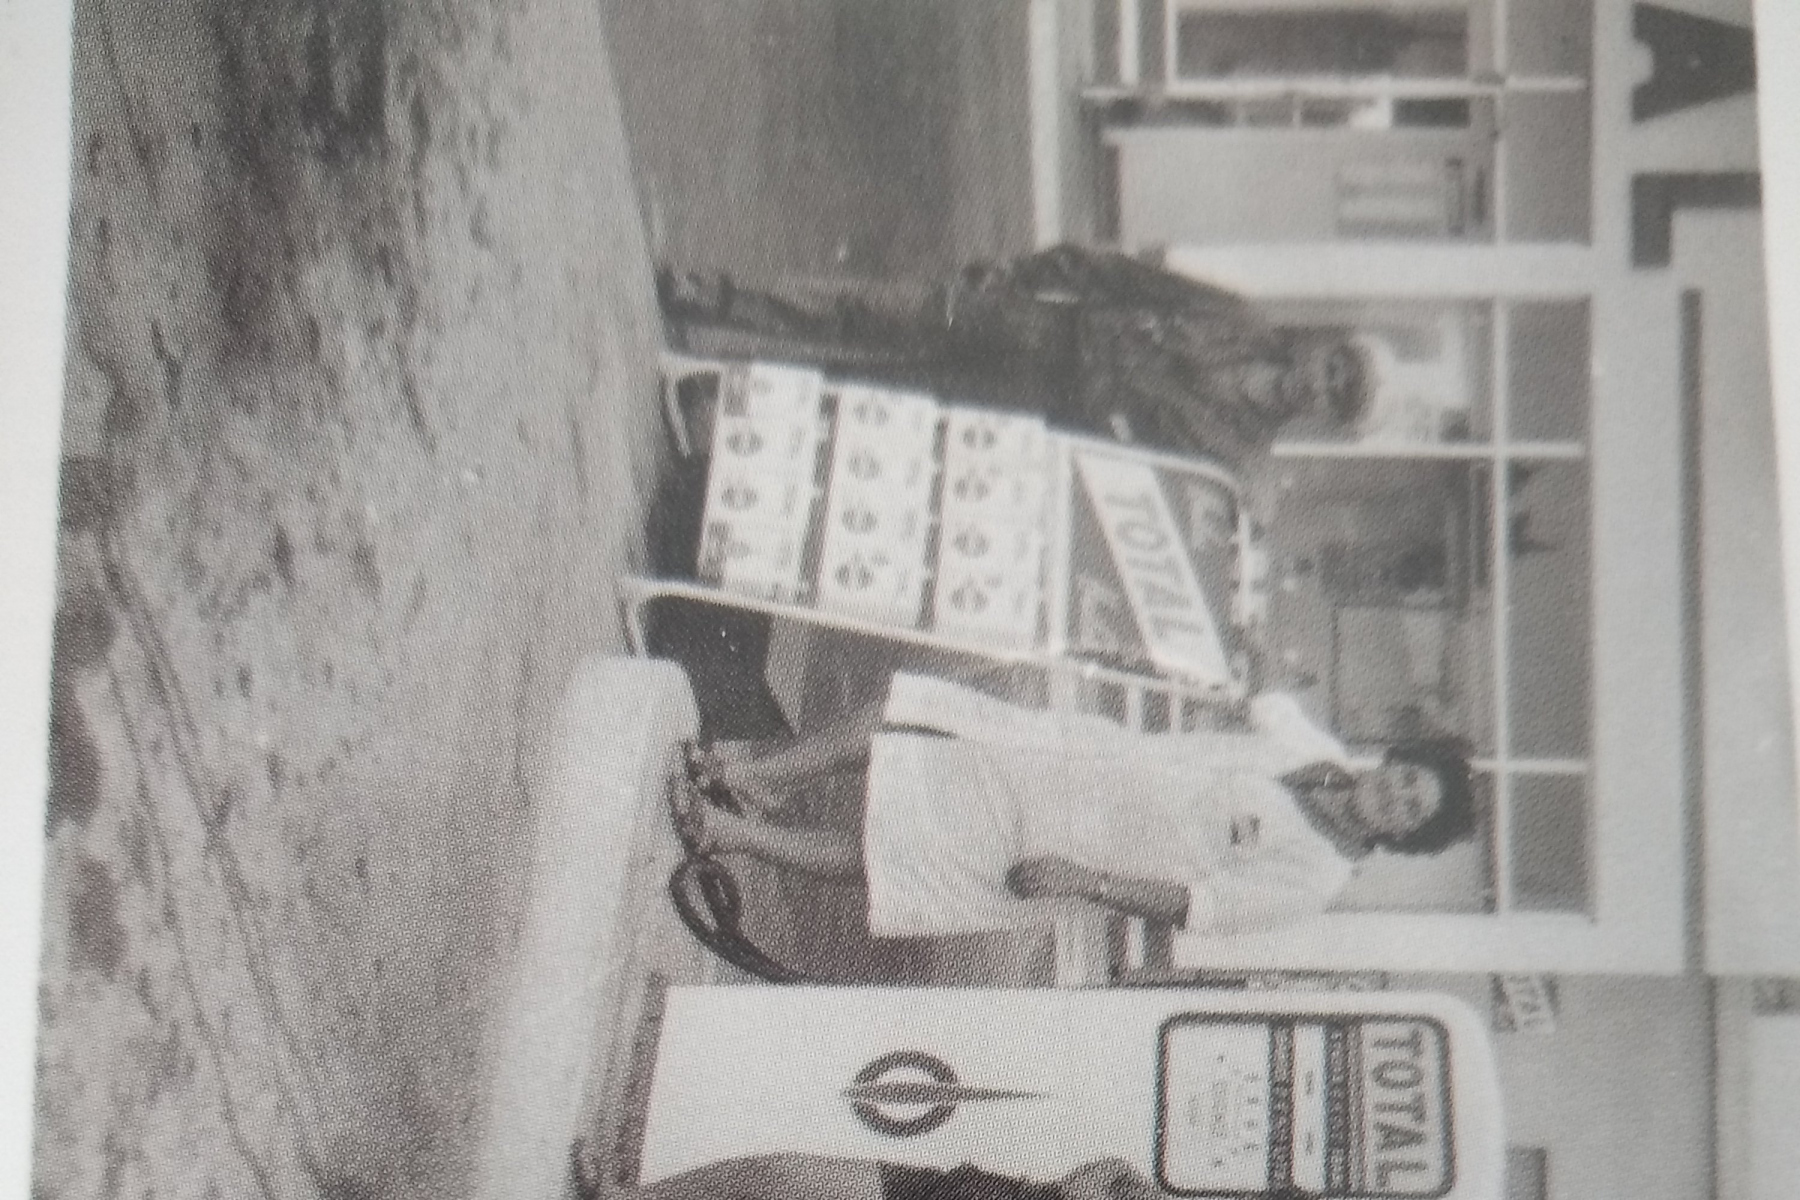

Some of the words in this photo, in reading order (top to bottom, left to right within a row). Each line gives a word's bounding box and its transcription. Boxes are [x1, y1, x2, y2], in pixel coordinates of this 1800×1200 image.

[1631, 2, 1762, 269] AL
[1104, 493, 1204, 640] TOTAL
[1372, 1029, 1428, 1188] TOTAL
